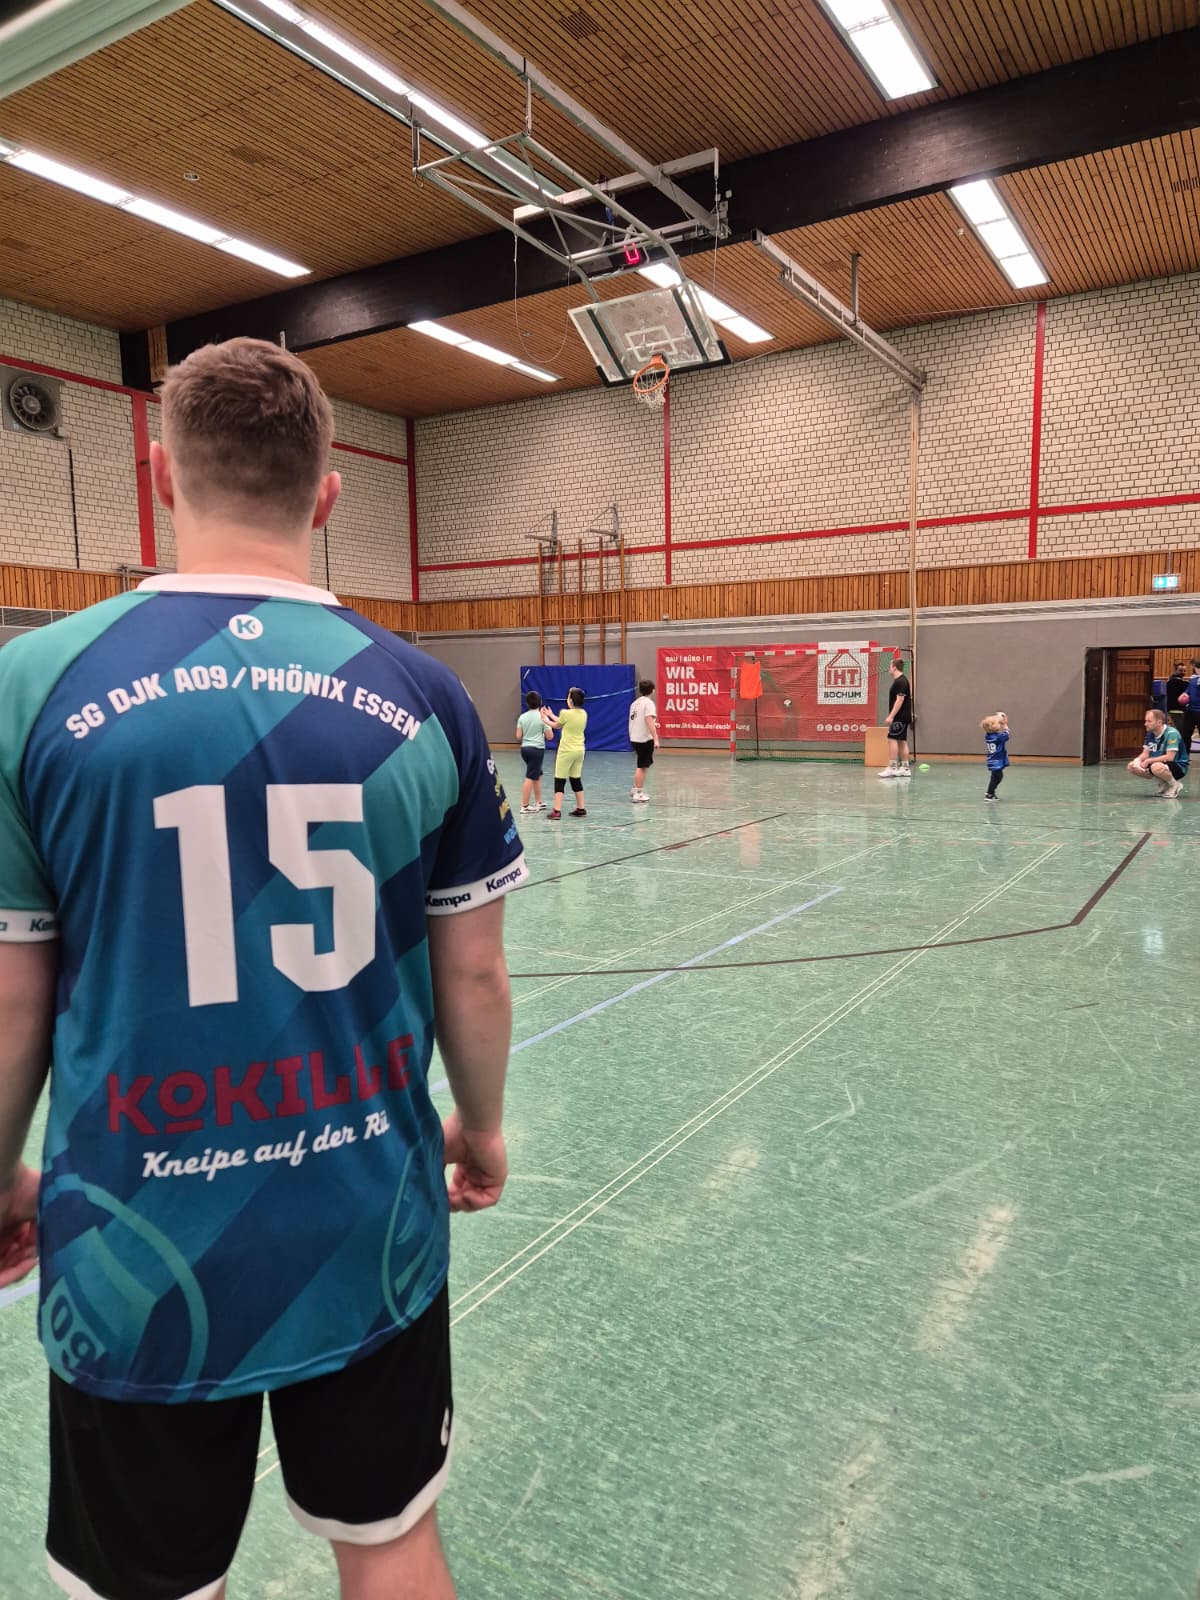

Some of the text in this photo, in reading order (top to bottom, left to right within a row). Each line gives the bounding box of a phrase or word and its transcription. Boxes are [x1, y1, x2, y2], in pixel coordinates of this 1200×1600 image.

[665, 666, 695, 679] WIR
[826, 669, 859, 685] IHT
[665, 682, 719, 695] BILDEN
[66, 703, 106, 739] SG
[107, 673, 168, 714] DJK
[352, 687, 421, 741] ESSEN
[665, 698, 699, 711] AUS!
[485, 867, 522, 892] Kempa
[153, 784, 376, 1007] 15
[425, 893, 471, 907] Kempa
[106, 1033, 414, 1136] KOKILLE
[142, 1147, 249, 1182] Kneipe
[253, 1130, 308, 1167] auf
[312, 1124, 357, 1154] der
